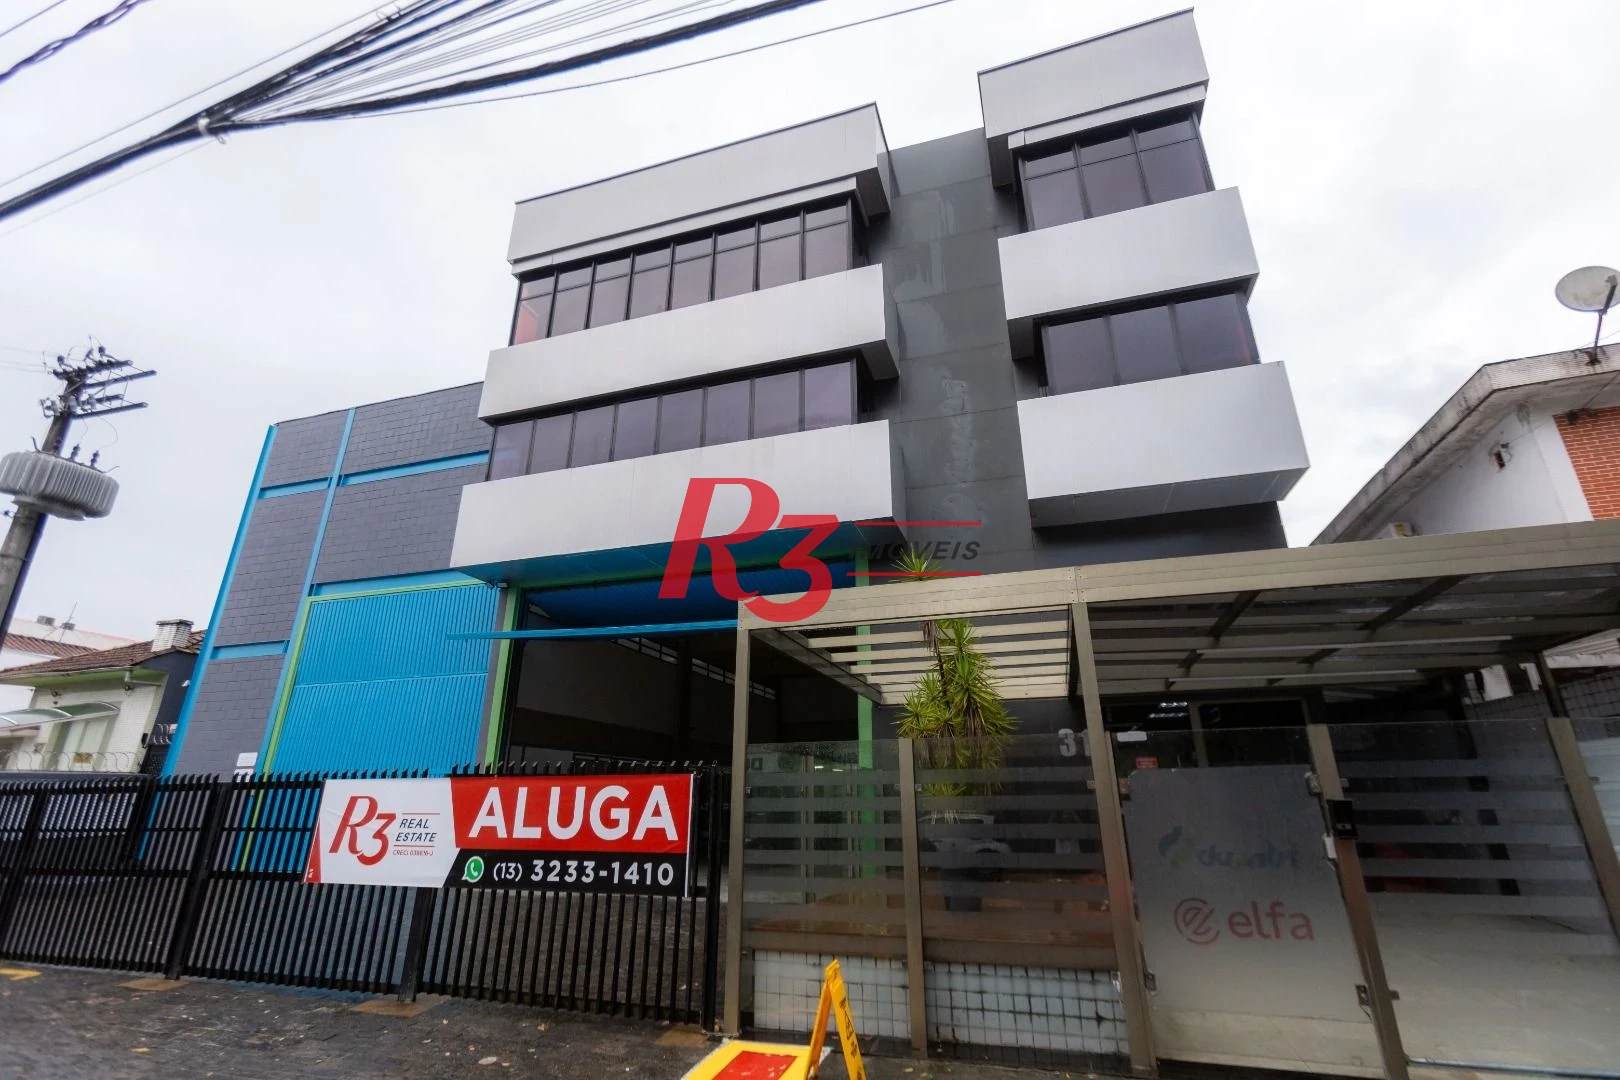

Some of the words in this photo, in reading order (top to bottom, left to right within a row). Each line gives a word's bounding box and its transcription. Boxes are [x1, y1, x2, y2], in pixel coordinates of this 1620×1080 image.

[399, 818, 430, 829] REAL
[468, 785, 679, 841] ALUGA
[329, 796, 397, 866] R3
[395, 832, 438, 842] ESTATE
[493, 861, 523, 883] (13)
[530, 859, 674, 886] 3233-1410
[1227, 900, 1315, 941] elfa
